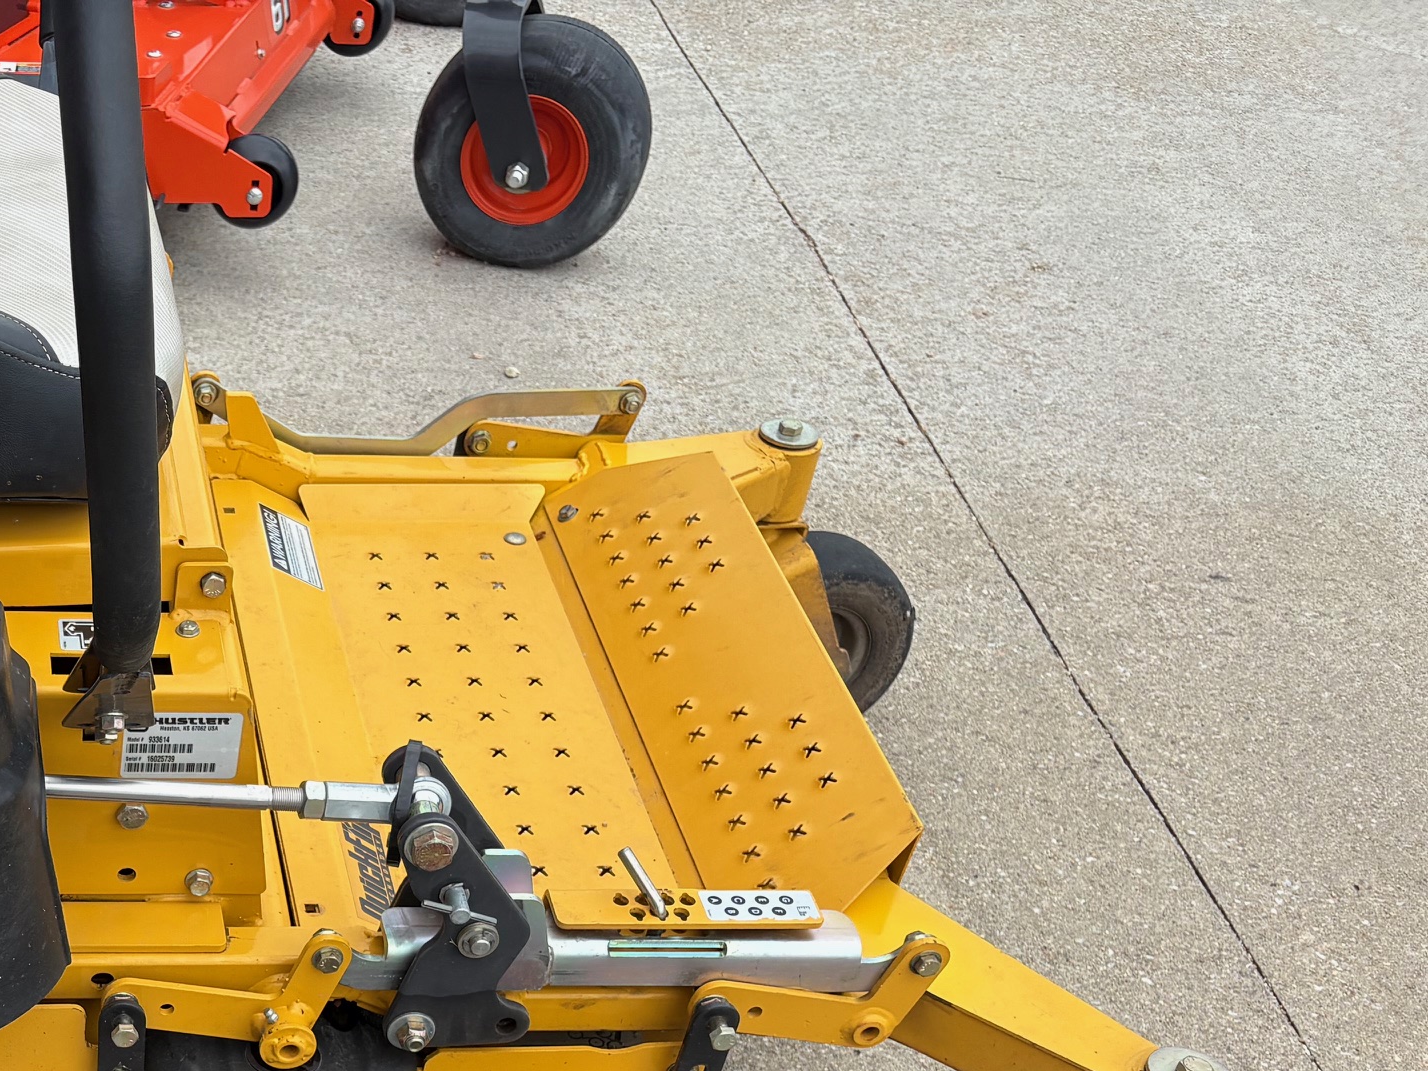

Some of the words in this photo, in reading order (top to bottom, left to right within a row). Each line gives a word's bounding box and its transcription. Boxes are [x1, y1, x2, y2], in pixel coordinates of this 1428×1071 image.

[263, 508, 286, 560] WARNING!
[154, 717, 230, 725] HUSTLER
[373, 835, 396, 901] CHNOLOGY
